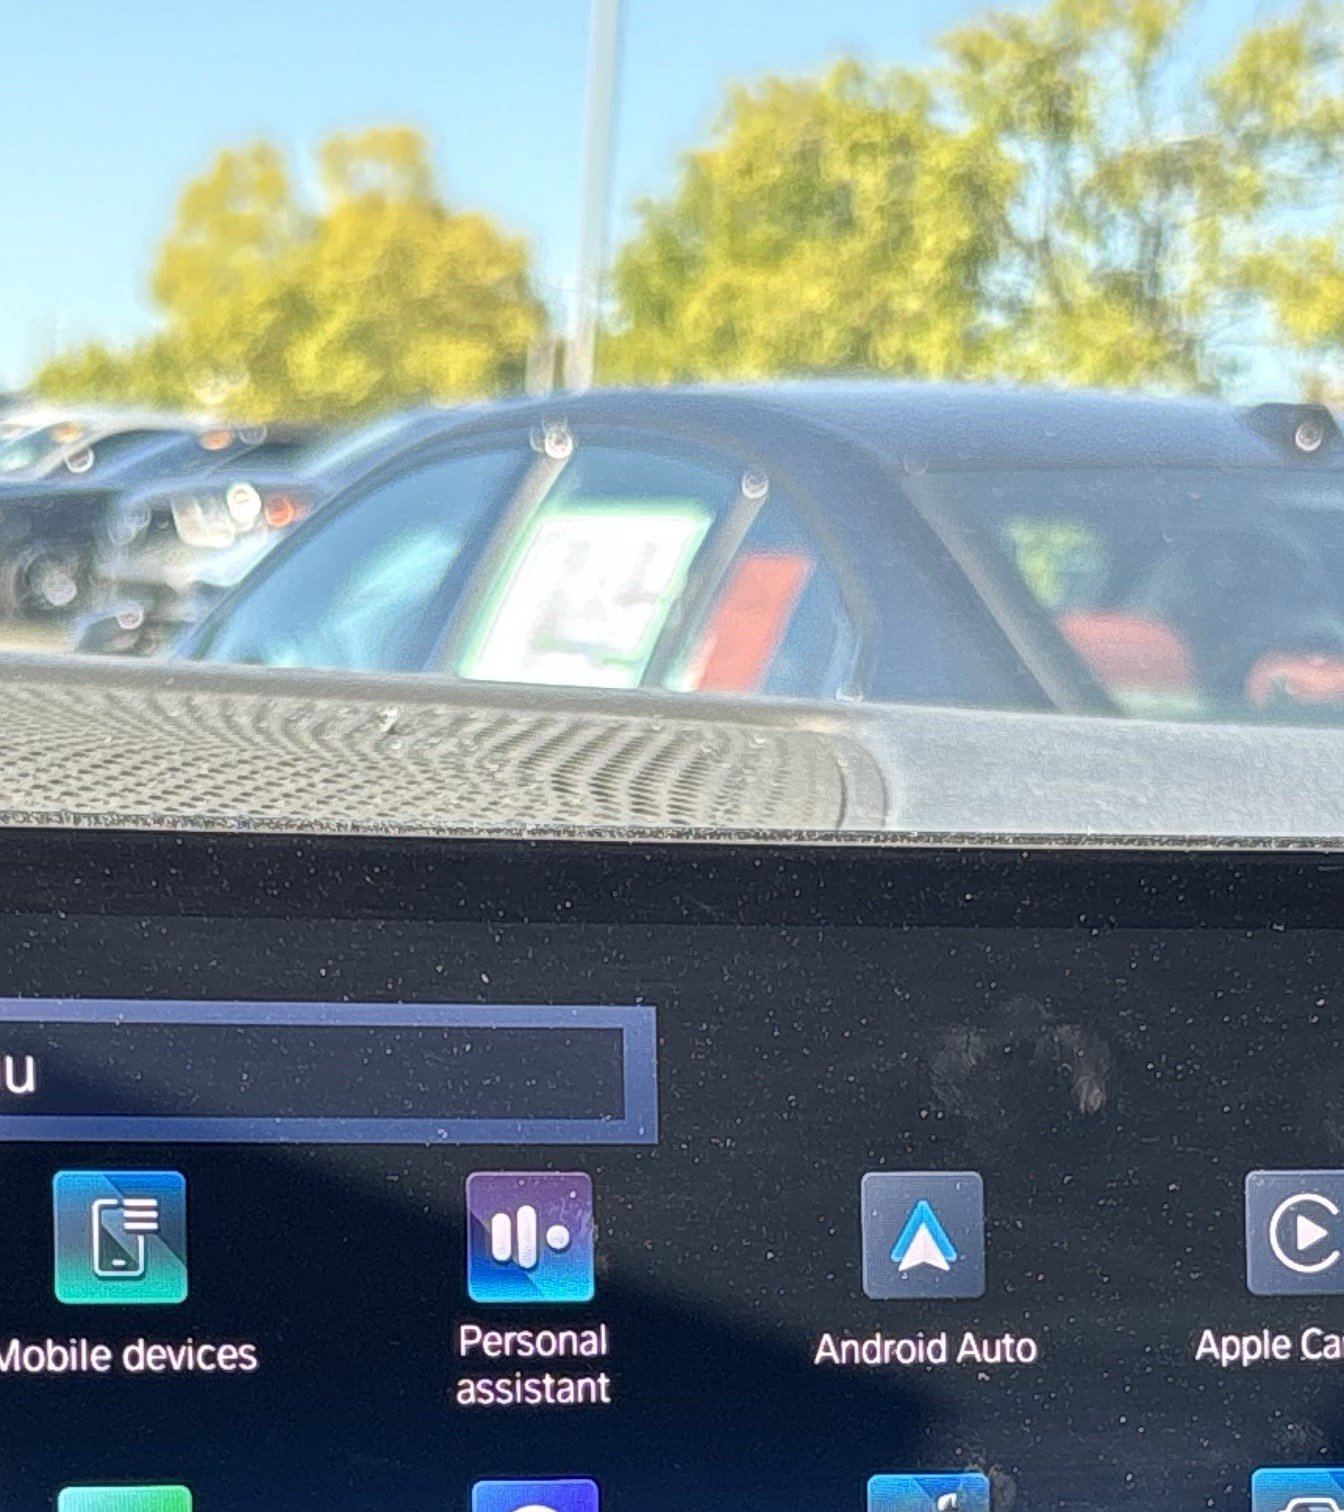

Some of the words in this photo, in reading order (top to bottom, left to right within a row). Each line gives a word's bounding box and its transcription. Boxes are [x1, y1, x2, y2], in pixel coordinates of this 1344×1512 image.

[122, 1339, 257, 1371] devices
[459, 1324, 608, 1359] Personal
[814, 1332, 947, 1366] Android
[957, 1332, 1037, 1363] Auto
[1196, 1329, 1292, 1367] Apple
[457, 1371, 611, 1405] assistant
